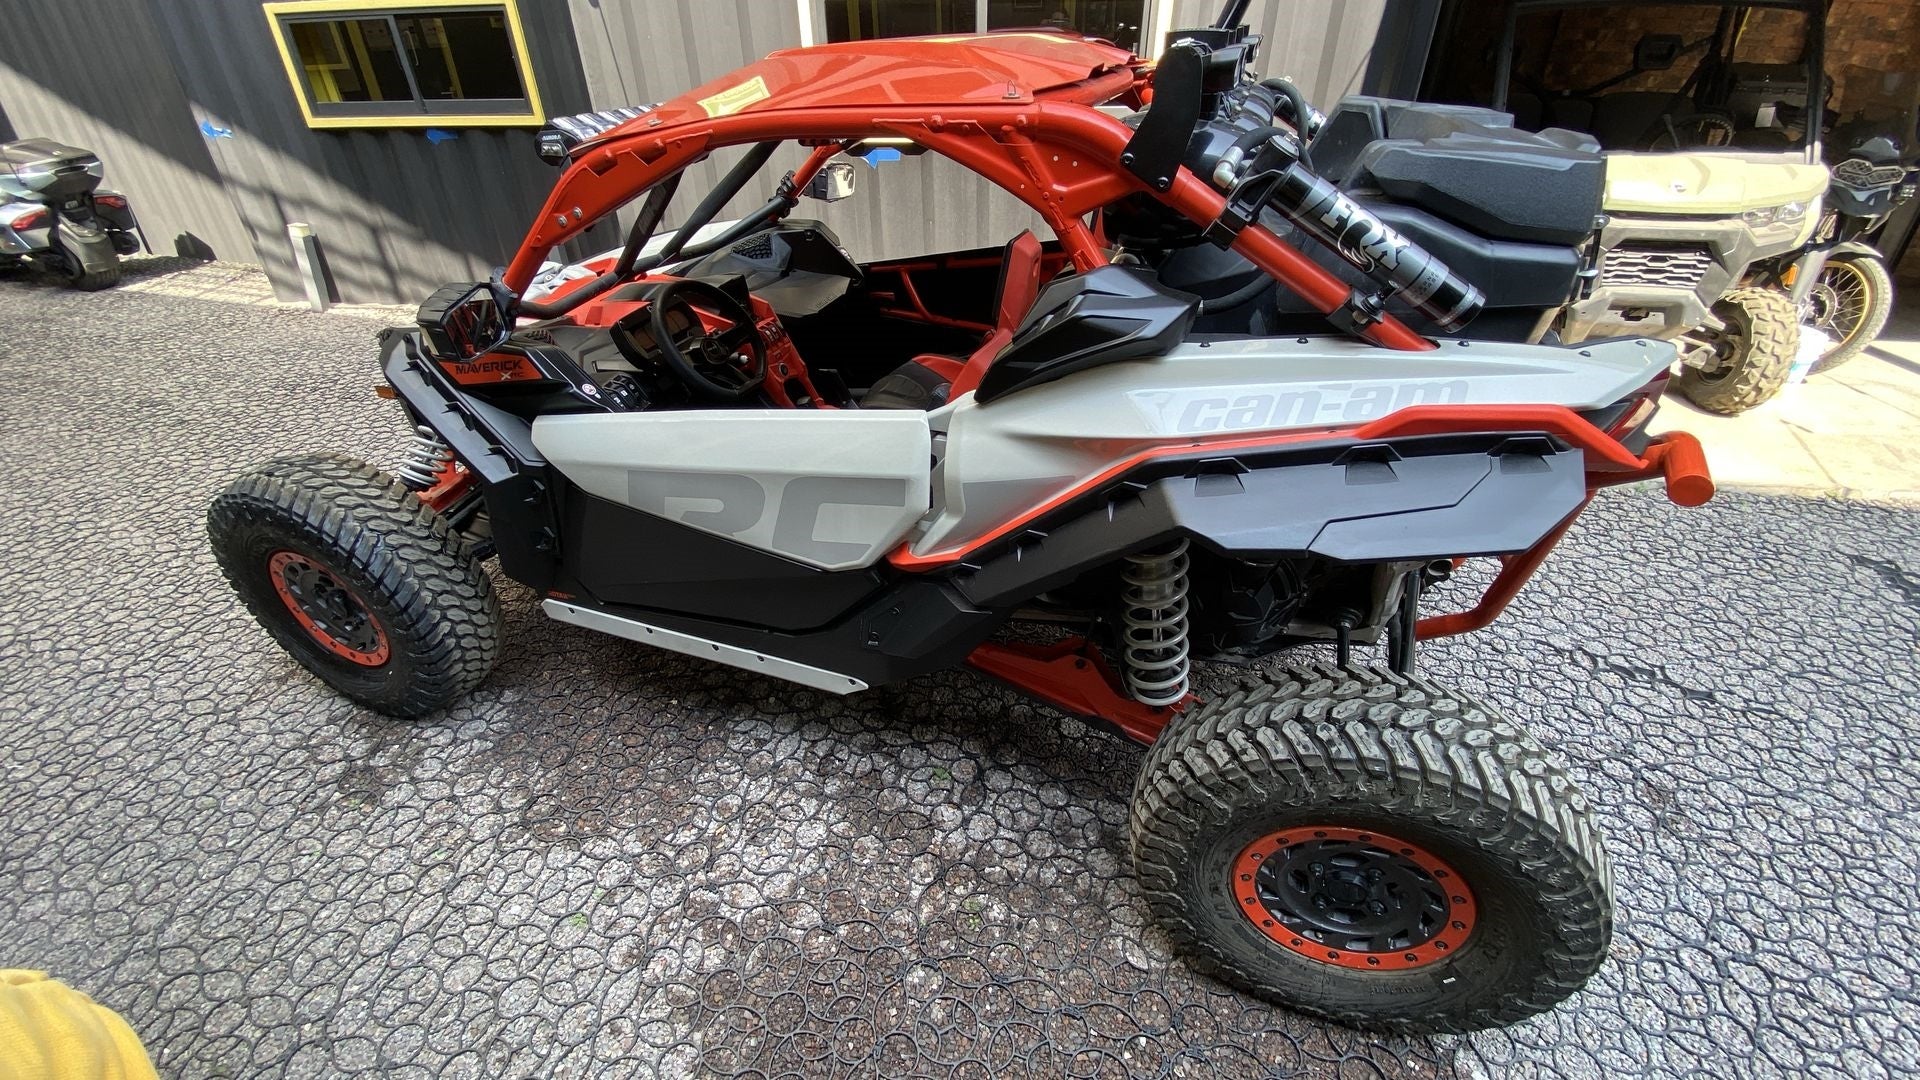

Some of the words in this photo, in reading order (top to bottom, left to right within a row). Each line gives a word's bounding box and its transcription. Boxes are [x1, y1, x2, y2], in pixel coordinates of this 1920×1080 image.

[1320, 191, 1412, 273] FOX
[455, 360, 523, 375] MAVERICK
[1177, 379, 1468, 434] can-am
